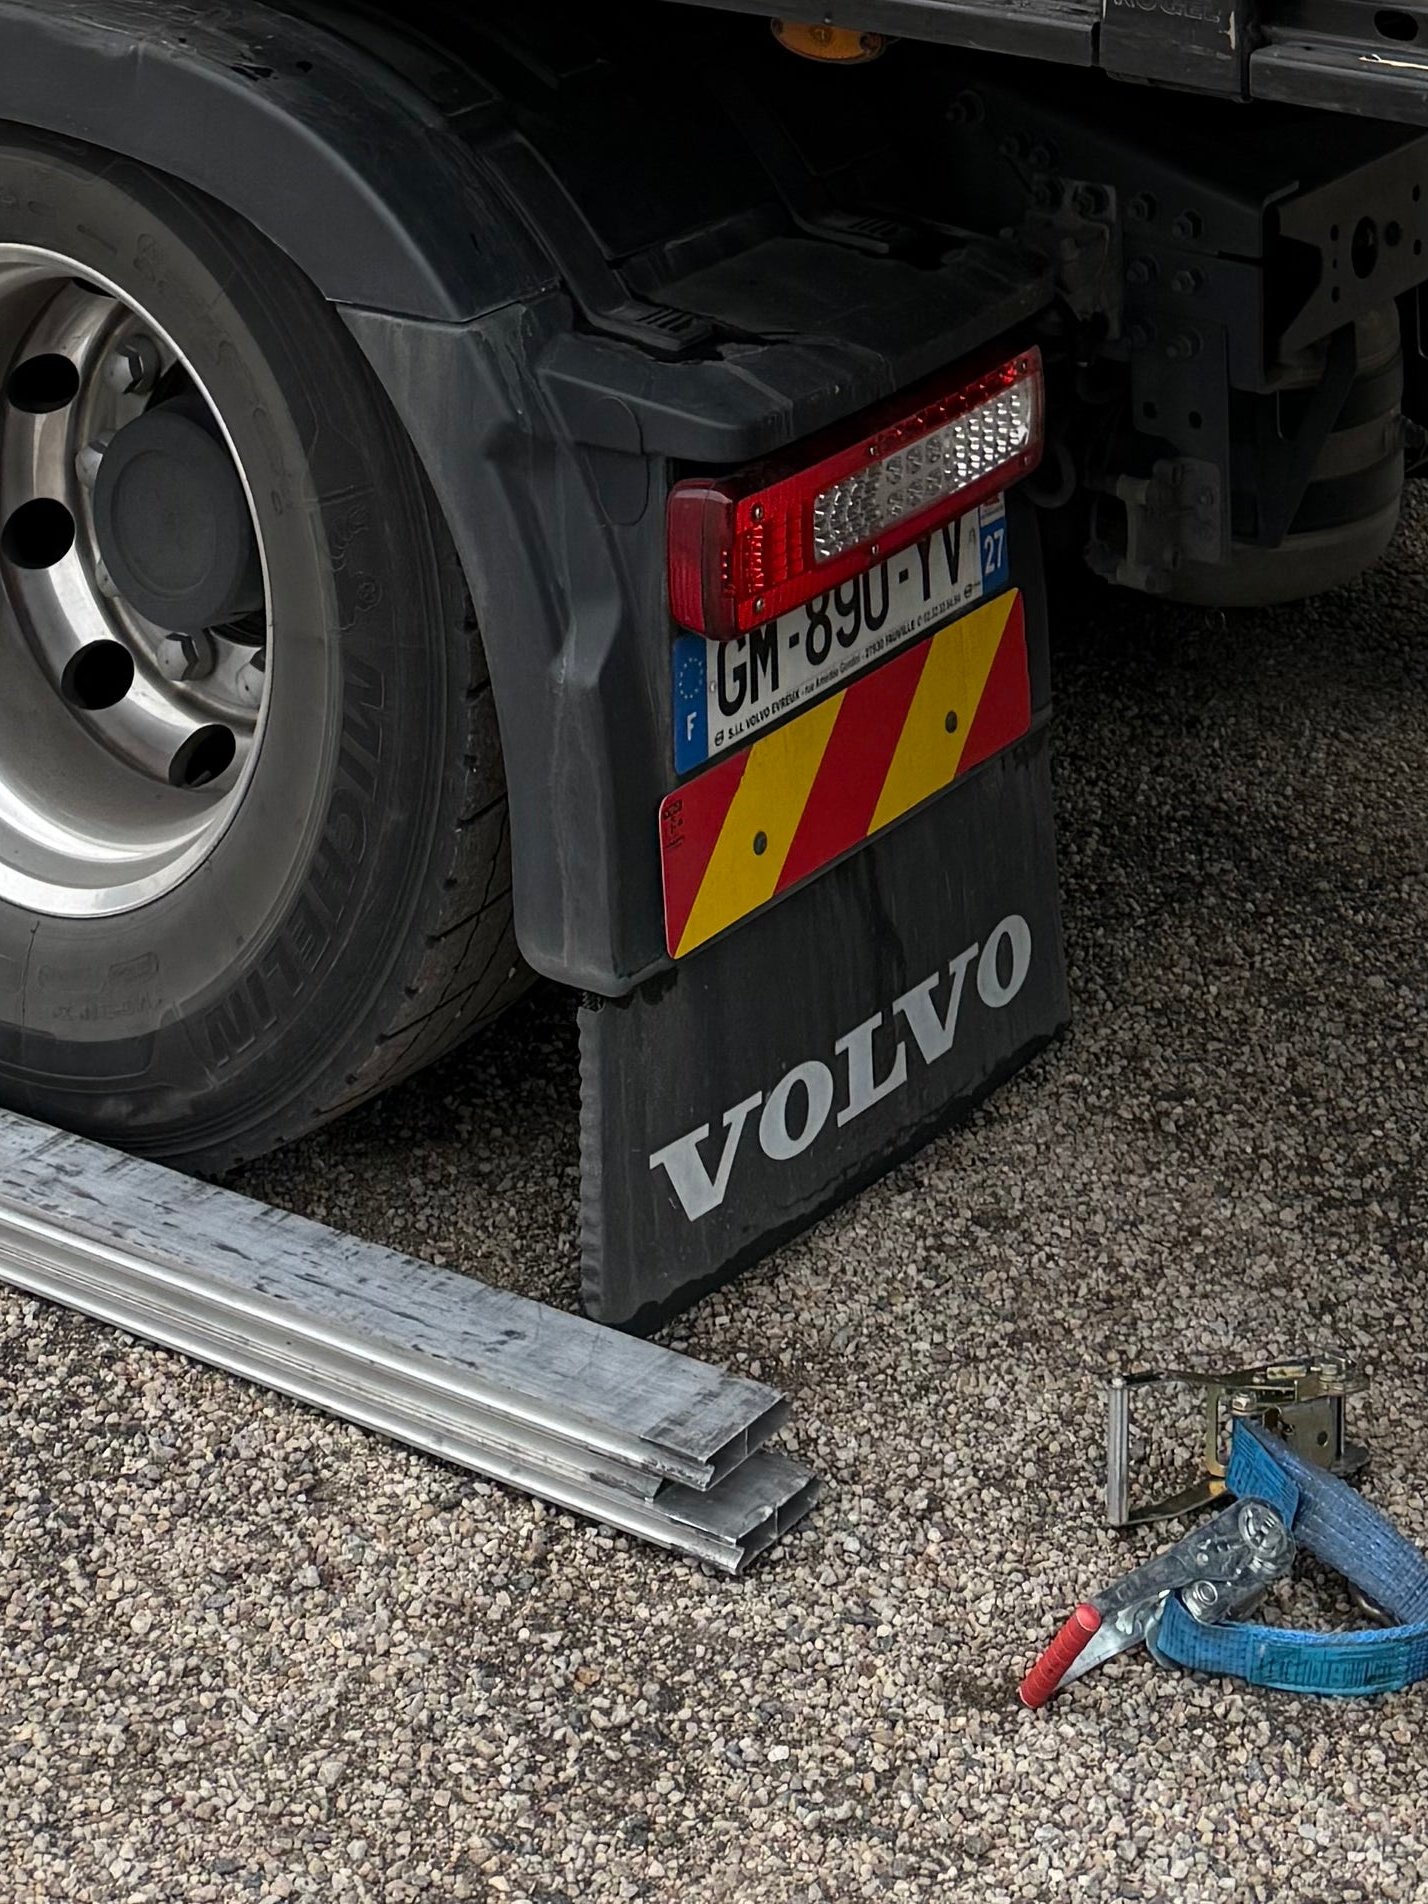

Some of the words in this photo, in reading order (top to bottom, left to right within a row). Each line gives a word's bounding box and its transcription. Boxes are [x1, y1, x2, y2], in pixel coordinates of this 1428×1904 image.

[983, 528, 1005, 576] 27
[717, 514, 962, 718] GM-890-YV
[686, 711, 698, 742] F
[649, 913, 1032, 1222] VOLVO
